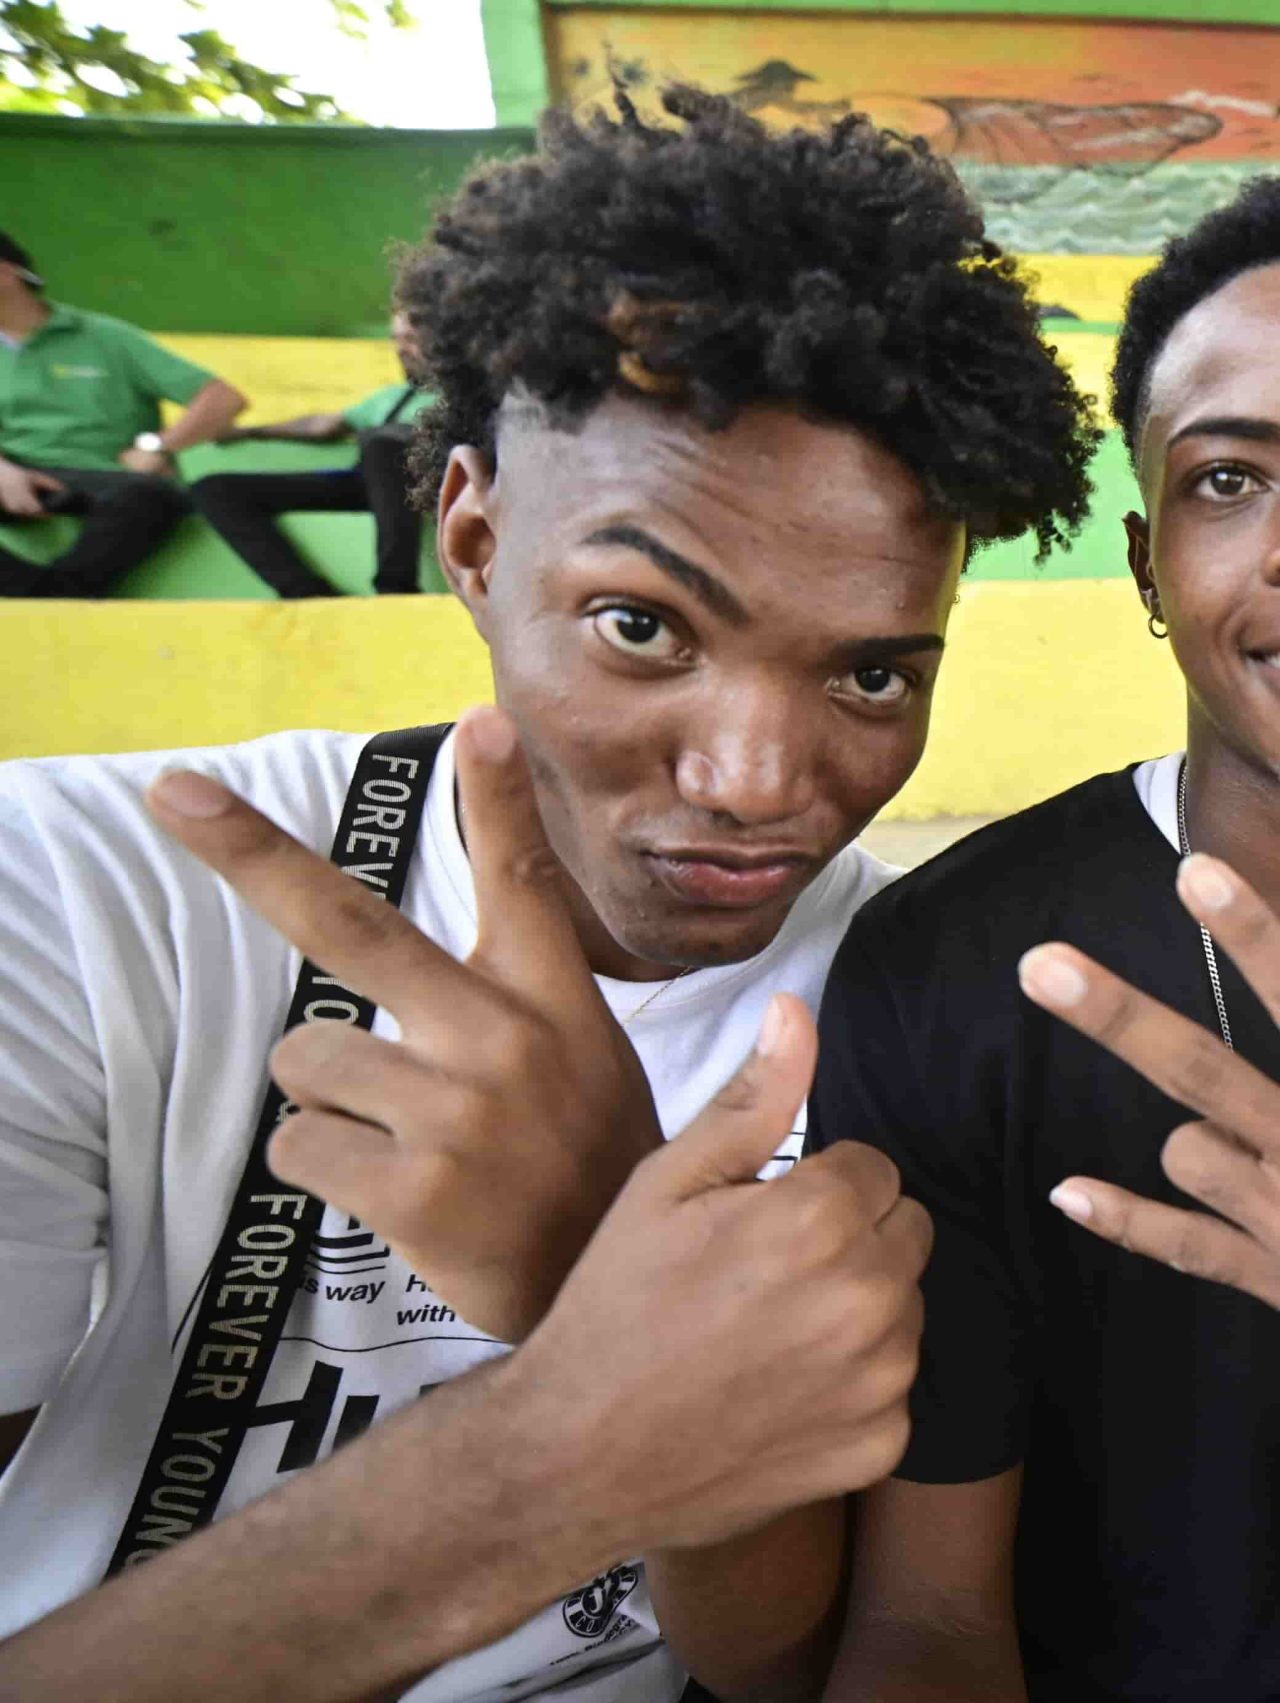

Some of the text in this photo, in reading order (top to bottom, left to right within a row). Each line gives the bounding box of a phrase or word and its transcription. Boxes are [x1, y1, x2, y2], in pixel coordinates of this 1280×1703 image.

[341, 754, 419, 900] FOREV
[185, 1194, 307, 1400] FOREVER
[326, 1281, 386, 1304] way
[397, 1304, 456, 1326] with
